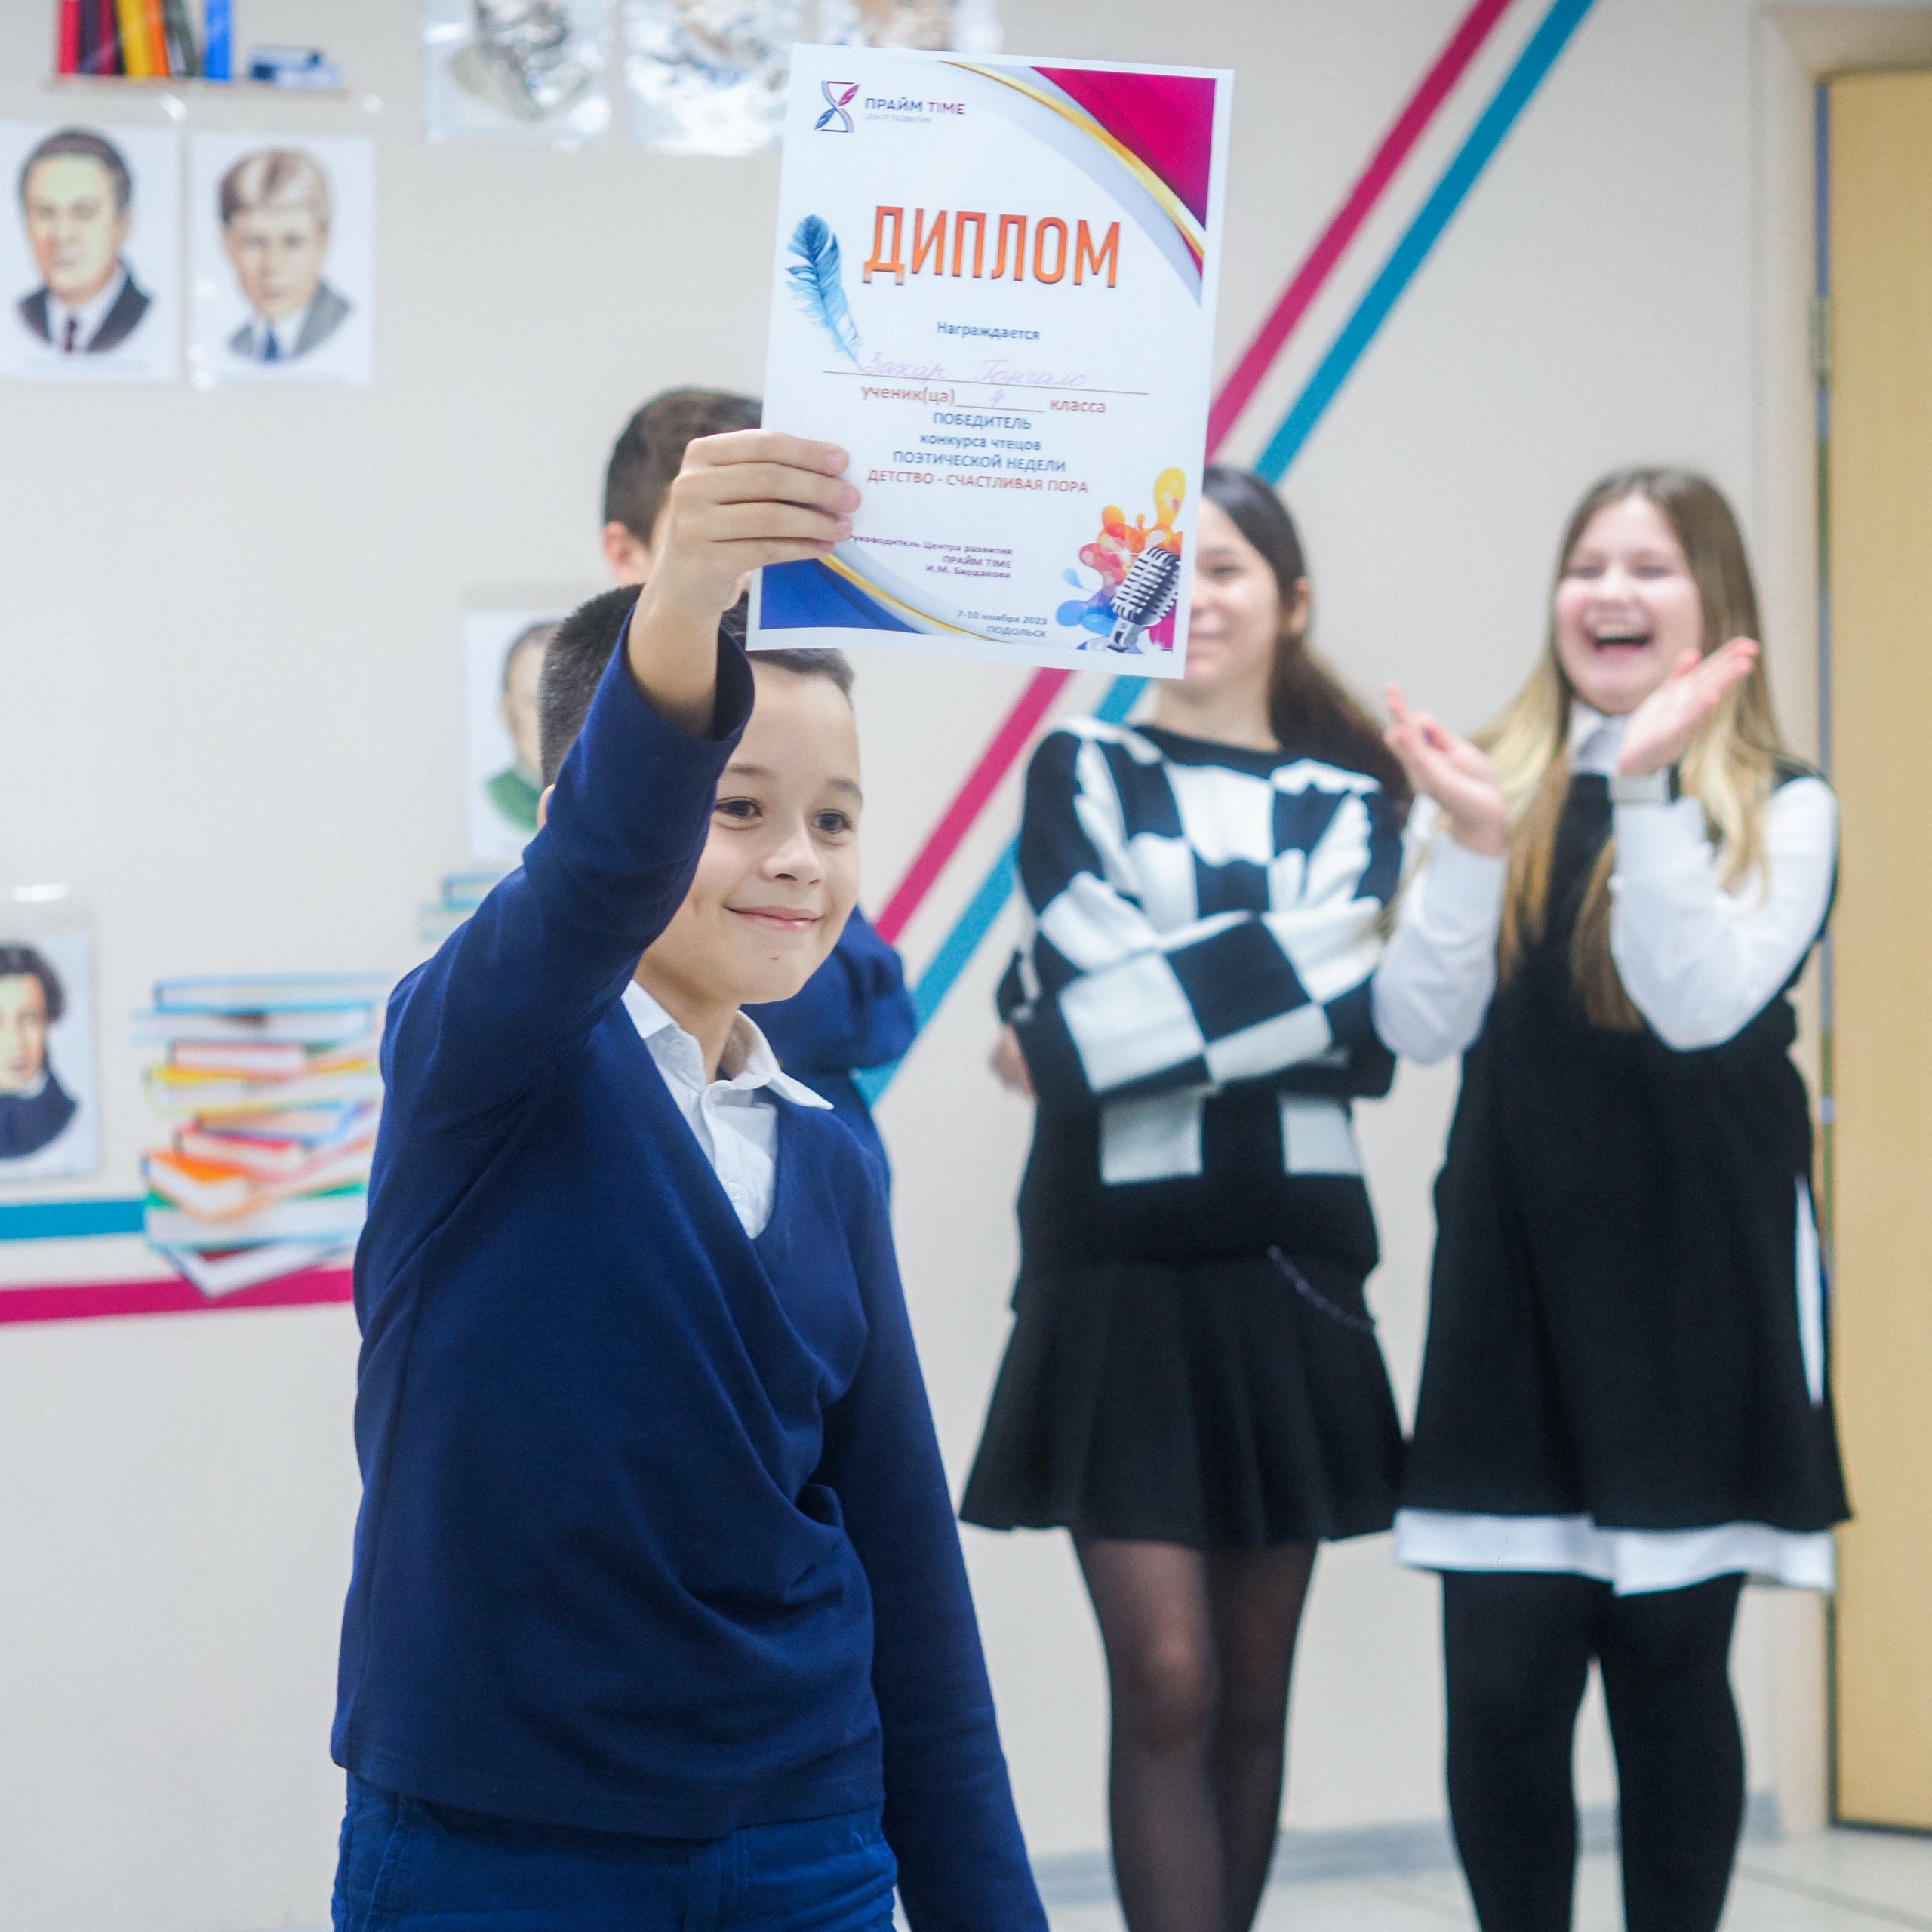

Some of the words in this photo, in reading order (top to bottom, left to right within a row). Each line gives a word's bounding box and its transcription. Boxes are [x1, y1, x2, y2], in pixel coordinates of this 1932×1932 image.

[864, 97, 923, 112] ПРАЙМ
[928, 101, 965, 115] TIME
[863, 205, 1121, 288] ДИПЛОМ
[937, 321, 1040, 340] Награждается
[863, 351, 949, 384] Захар
[1050, 399, 1106, 413] класса
[933, 412, 1032, 429] ПОБЕДИТЕЛЬ
[920, 434, 987, 449] конкурса
[991, 439, 1041, 451] чтецов
[892, 450, 1002, 469] ПОЭТИЧЕСКОЙ
[1006, 457, 1066, 473] НЕДЕЛИ
[867, 469, 934, 485] ДЕТСТВО
[946, 474, 1043, 491] СЧАСТЛИВАЯ
[1048, 480, 1089, 493] ПОРА
[923, 541, 961, 552] Центра
[964, 546, 1013, 555] развития
[943, 555, 983, 566] ПРАЙМ
[957, 610, 980, 619] 7-10
[982, 614, 1020, 623] ноября
[1023, 616, 1048, 625] 2023
[986, 625, 1047, 638] ПОДОЛЬСК
